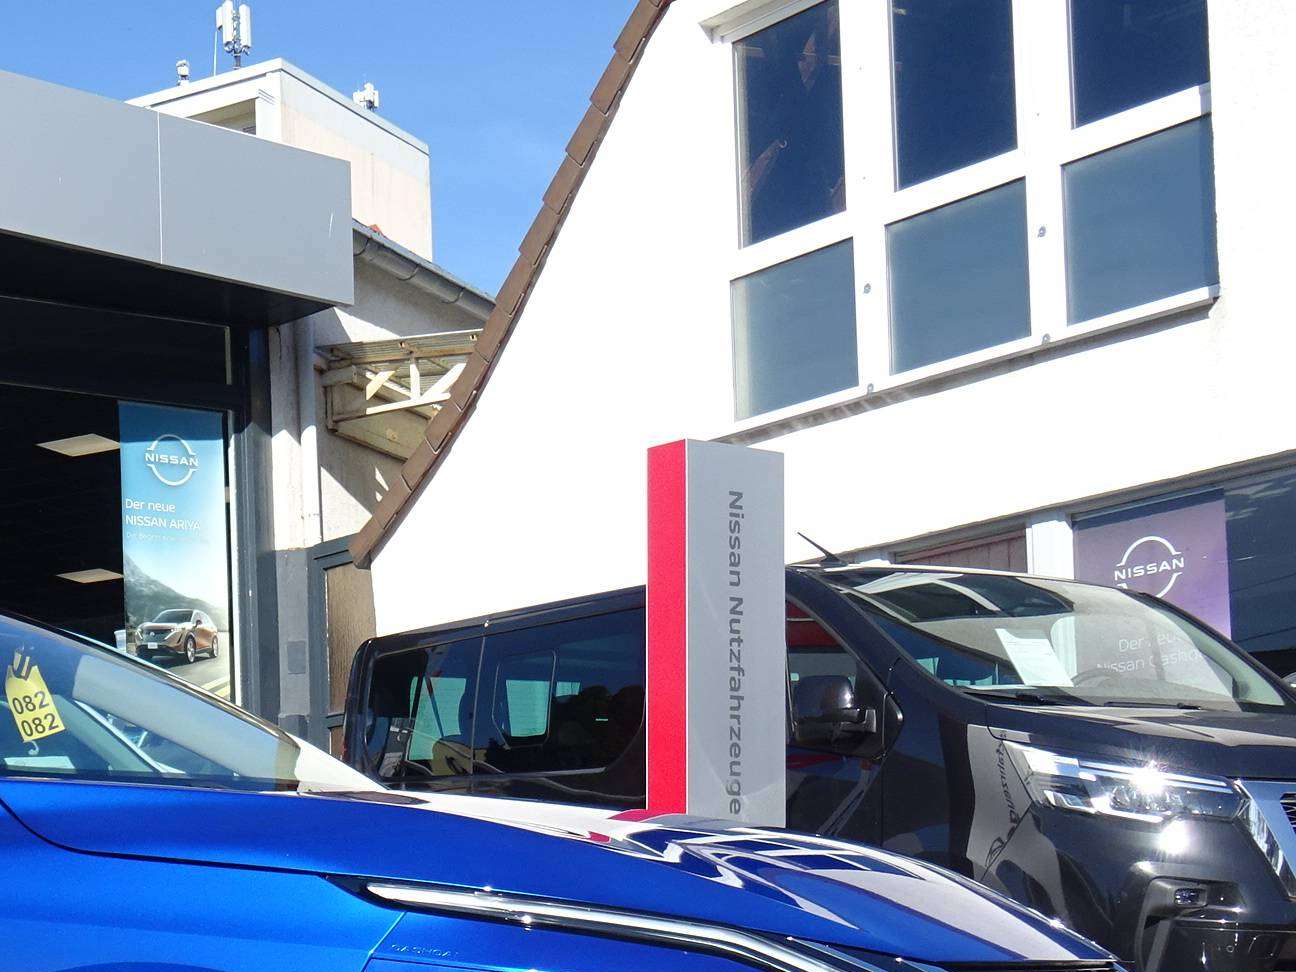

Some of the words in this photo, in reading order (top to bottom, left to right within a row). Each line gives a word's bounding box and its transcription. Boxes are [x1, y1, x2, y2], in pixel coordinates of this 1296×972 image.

[145, 452, 199, 467] NISSAN
[125, 498, 144, 510] Der
[147, 502, 176, 513] neue
[125, 514, 167, 527] NISSAN
[169, 519, 201, 530] ARIYA
[728, 489, 745, 588] Nissan
[1114, 557, 1185, 581] NISSAN
[1118, 637, 1144, 652] Der
[1097, 659, 1145, 673] issan
[12, 690, 50, 715] 082
[726, 596, 745, 816] Nutzfahrzeuge
[21, 712, 59, 737] 082
